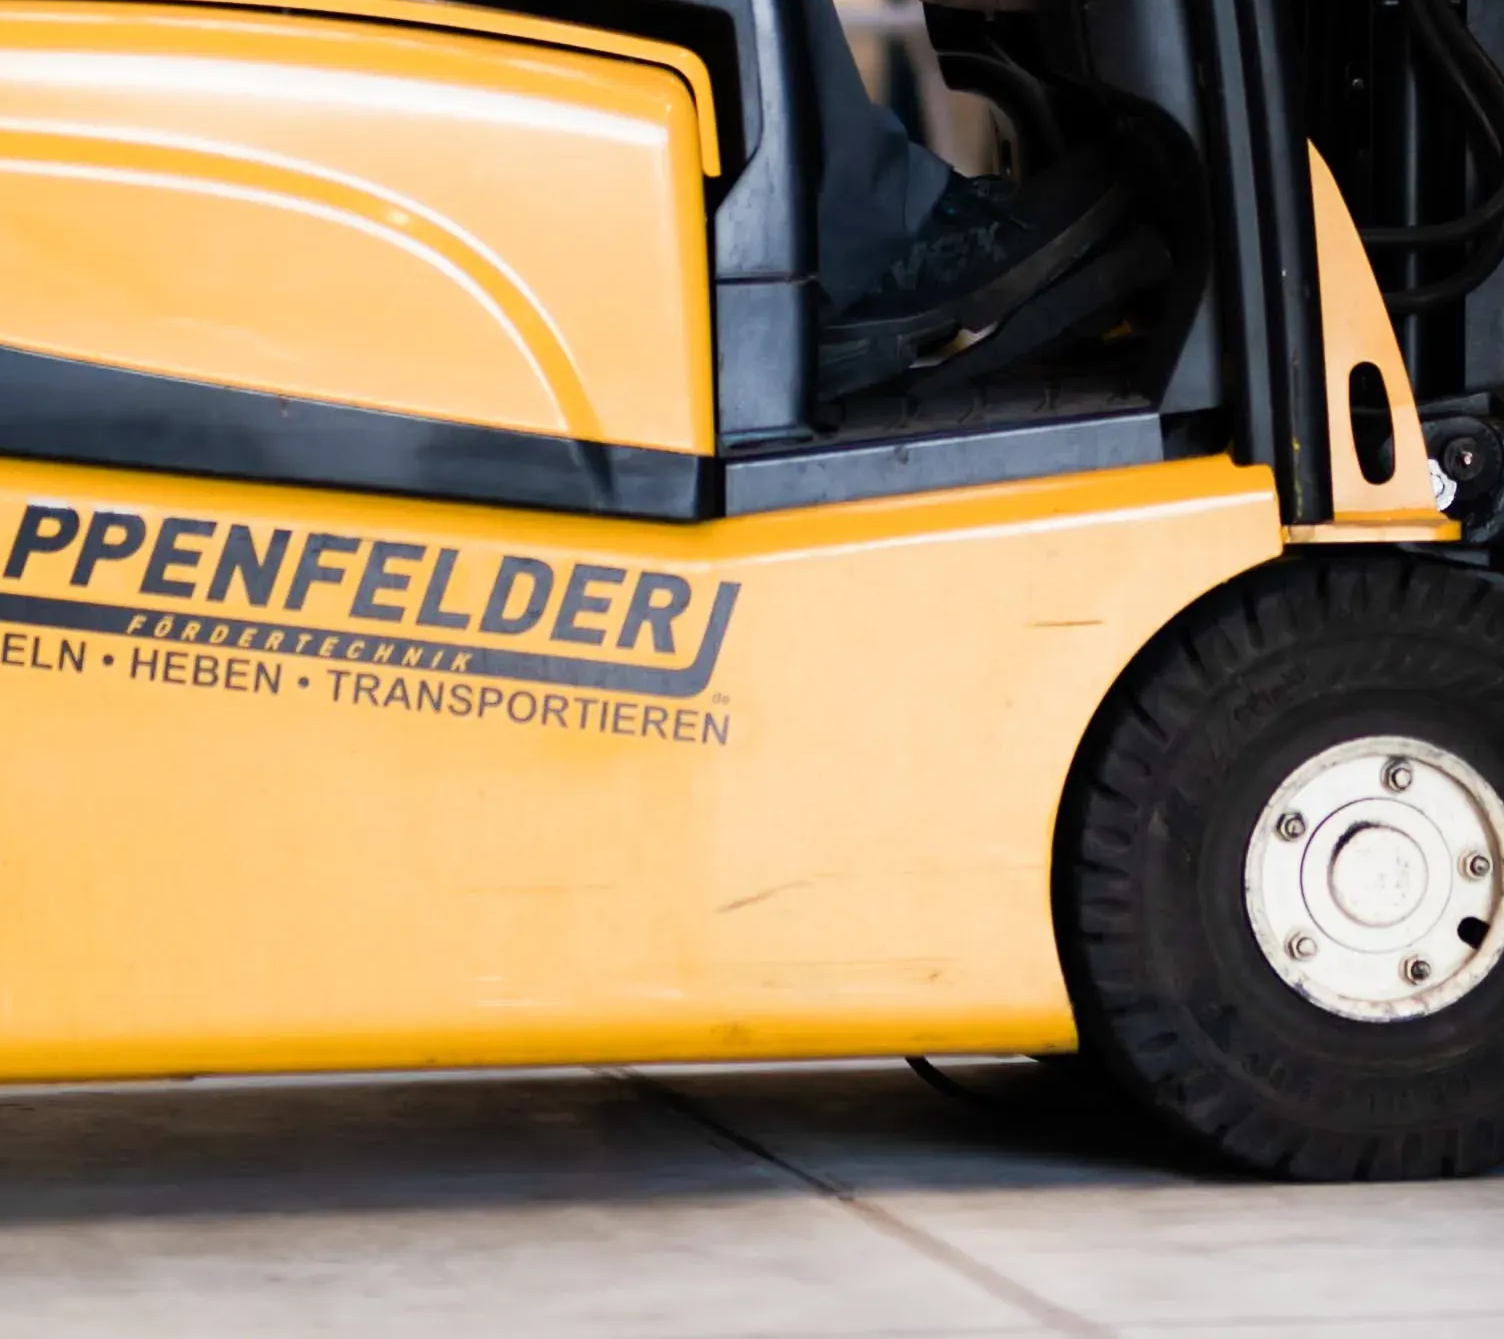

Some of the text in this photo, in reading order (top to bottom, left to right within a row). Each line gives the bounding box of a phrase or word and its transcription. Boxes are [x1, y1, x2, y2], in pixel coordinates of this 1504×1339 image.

[126, 613, 474, 673] FÖRDERTECHNIK
[129, 646, 283, 695] HEBEN
[326, 668, 730, 746] TRANSPORTIEREN
